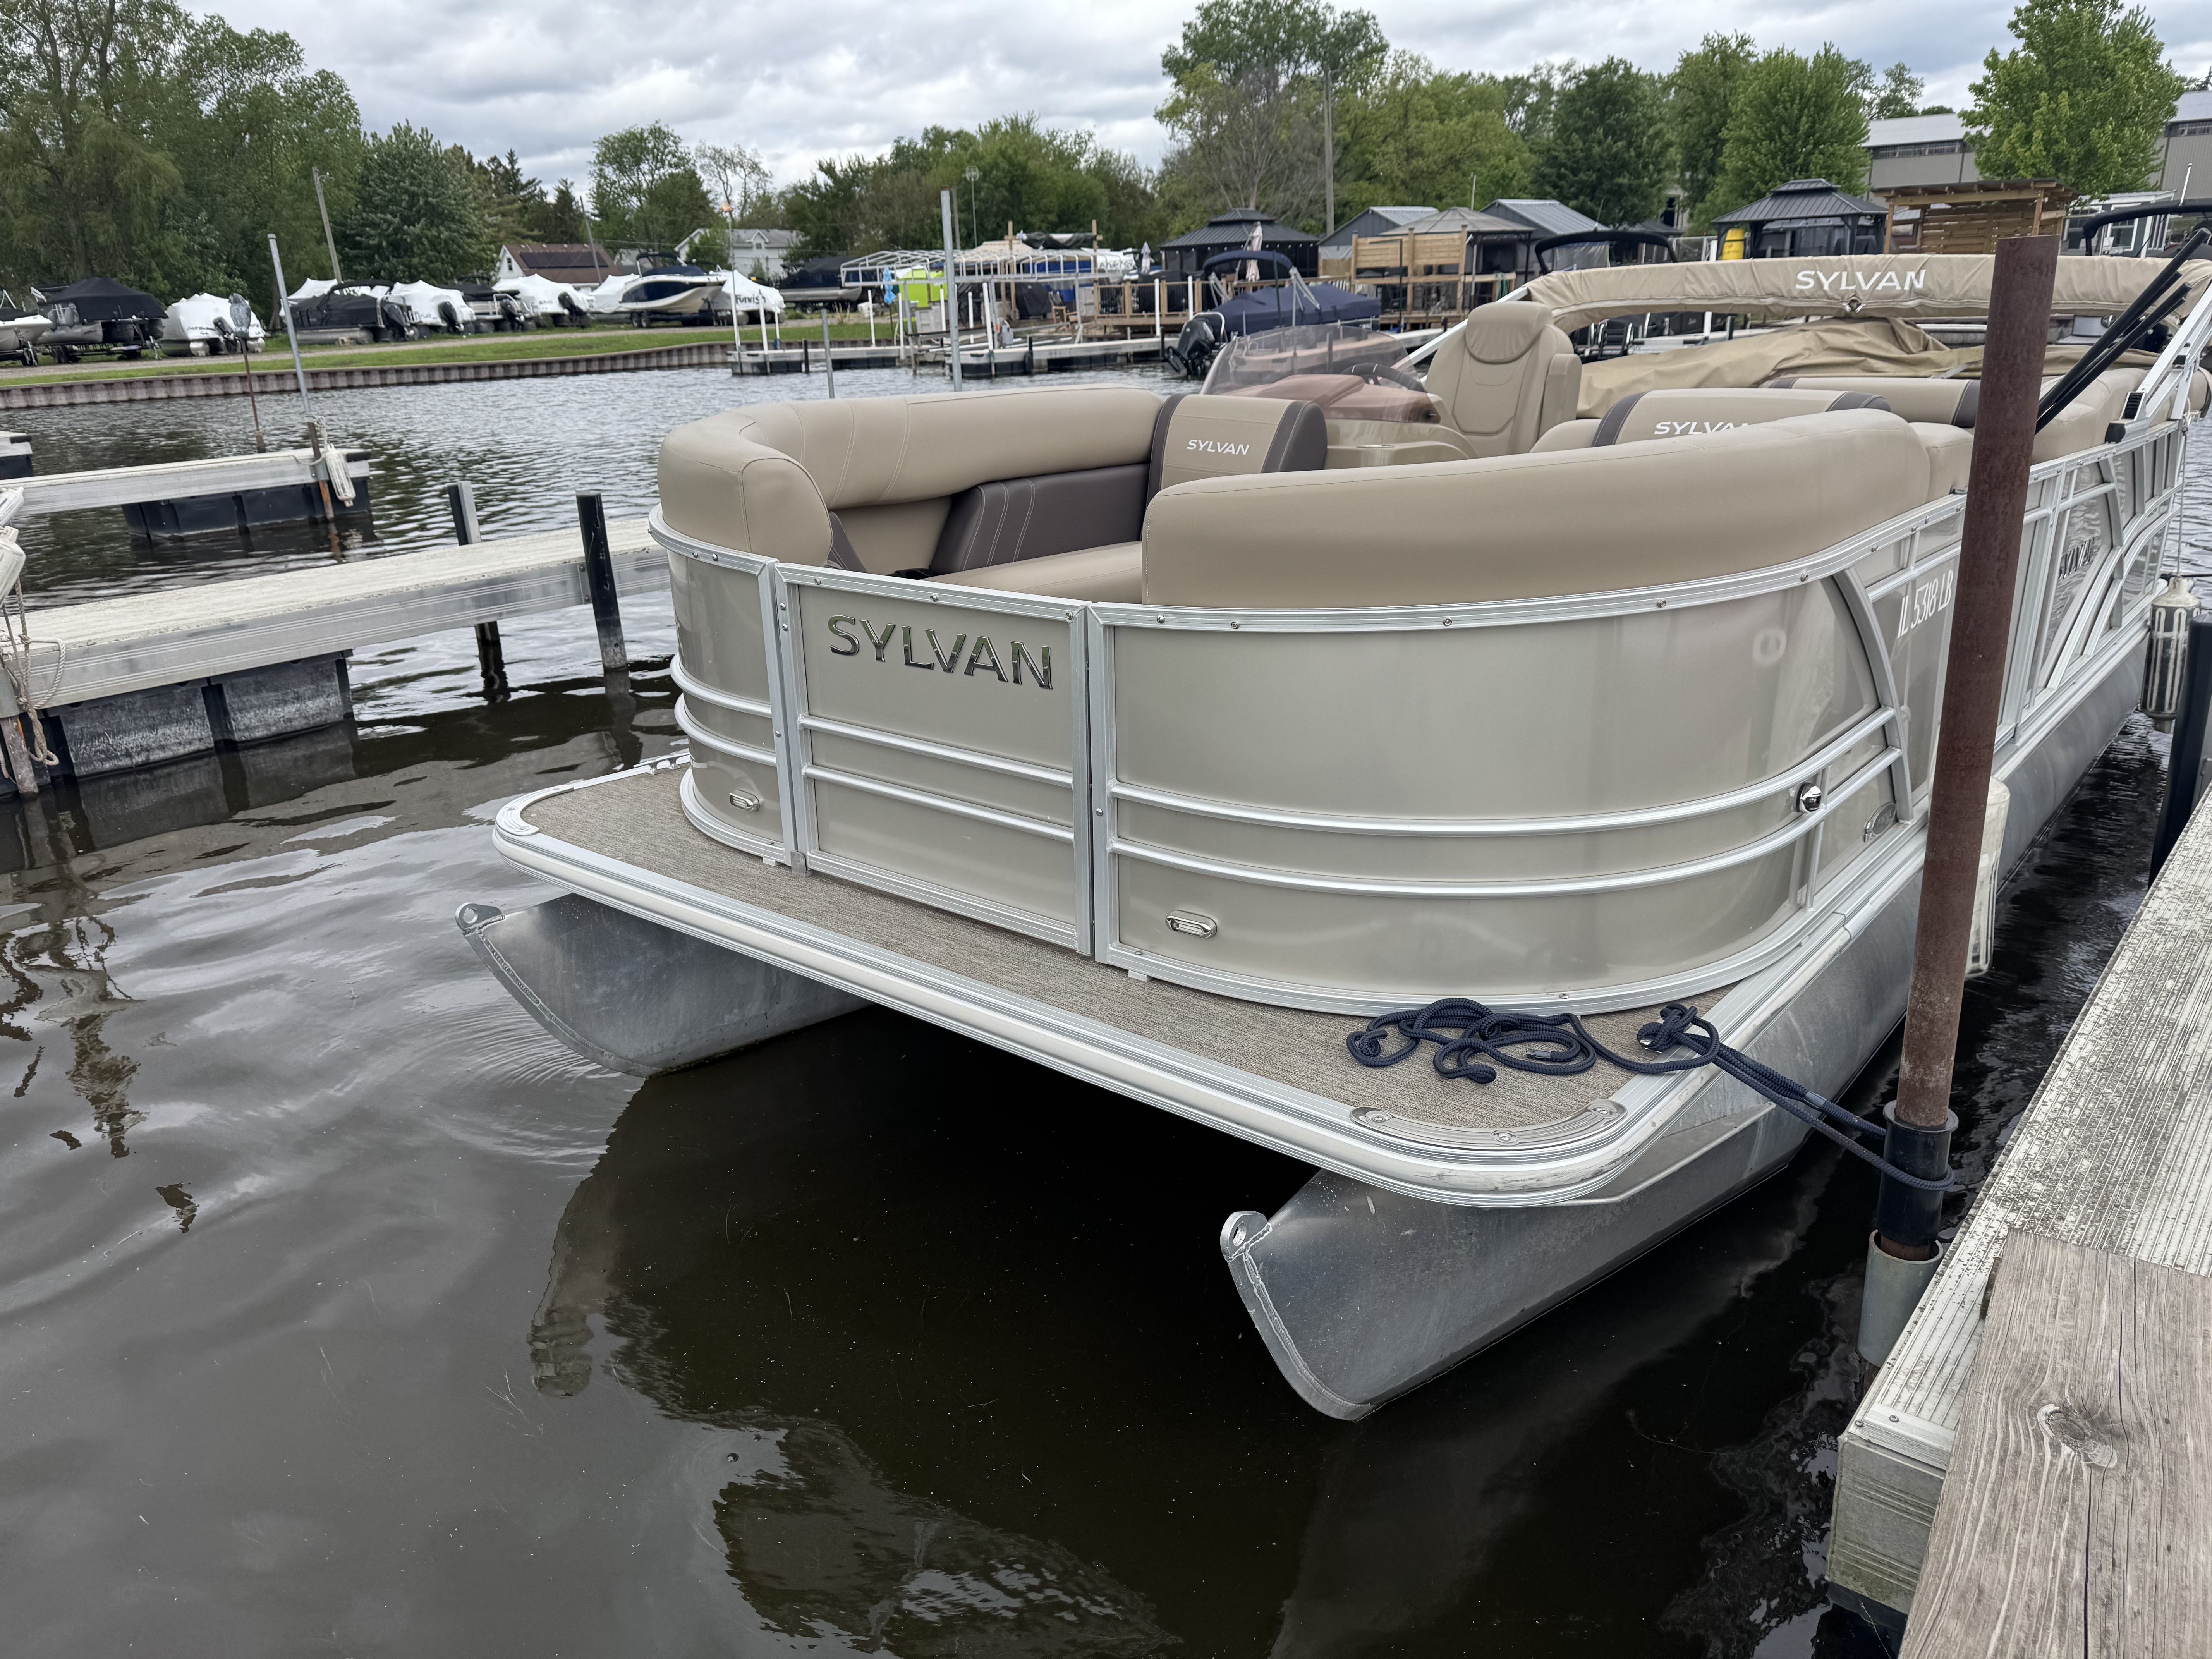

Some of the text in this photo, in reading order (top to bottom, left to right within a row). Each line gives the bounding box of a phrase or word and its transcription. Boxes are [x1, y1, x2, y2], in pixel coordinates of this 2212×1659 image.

[1795, 270, 1926, 290] SYLVAN
[1654, 421, 1748, 434] SYLVA
[1187, 440, 1249, 455] SYLVAN
[1897, 569, 1954, 639] IL 5318 LB
[827, 614, 1053, 690] SYLVAN
